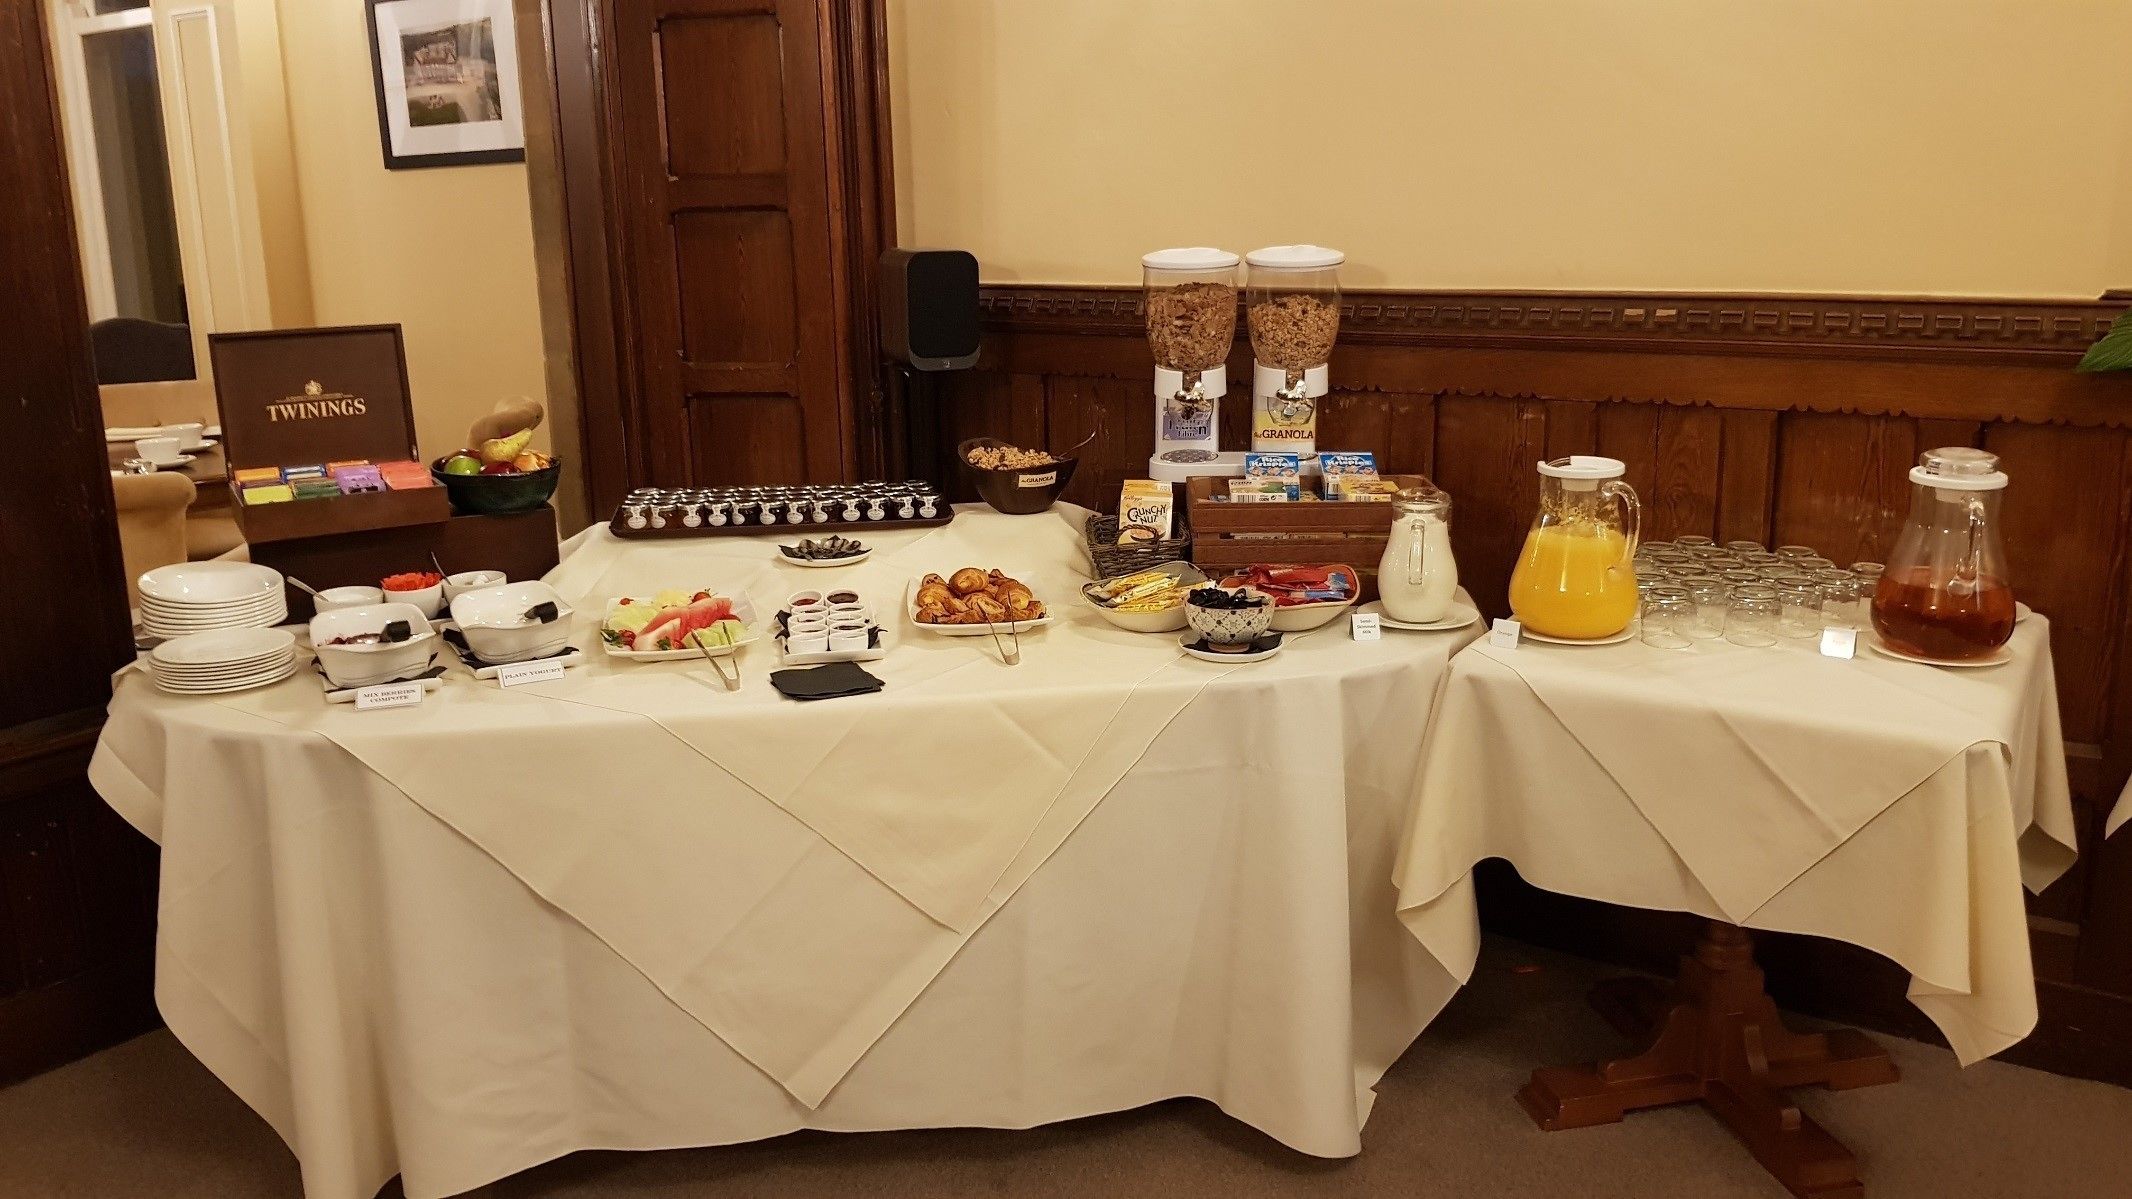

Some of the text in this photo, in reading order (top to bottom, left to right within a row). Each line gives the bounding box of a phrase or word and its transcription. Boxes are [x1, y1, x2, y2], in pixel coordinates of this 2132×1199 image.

[266, 398, 366, 421] TWININGS
[1262, 429, 1313, 439] GRANOLA
[1127, 504, 1167, 522] CRUNCHY
[1140, 514, 1157, 524] NUT
[504, 671, 527, 680] PLAIN
